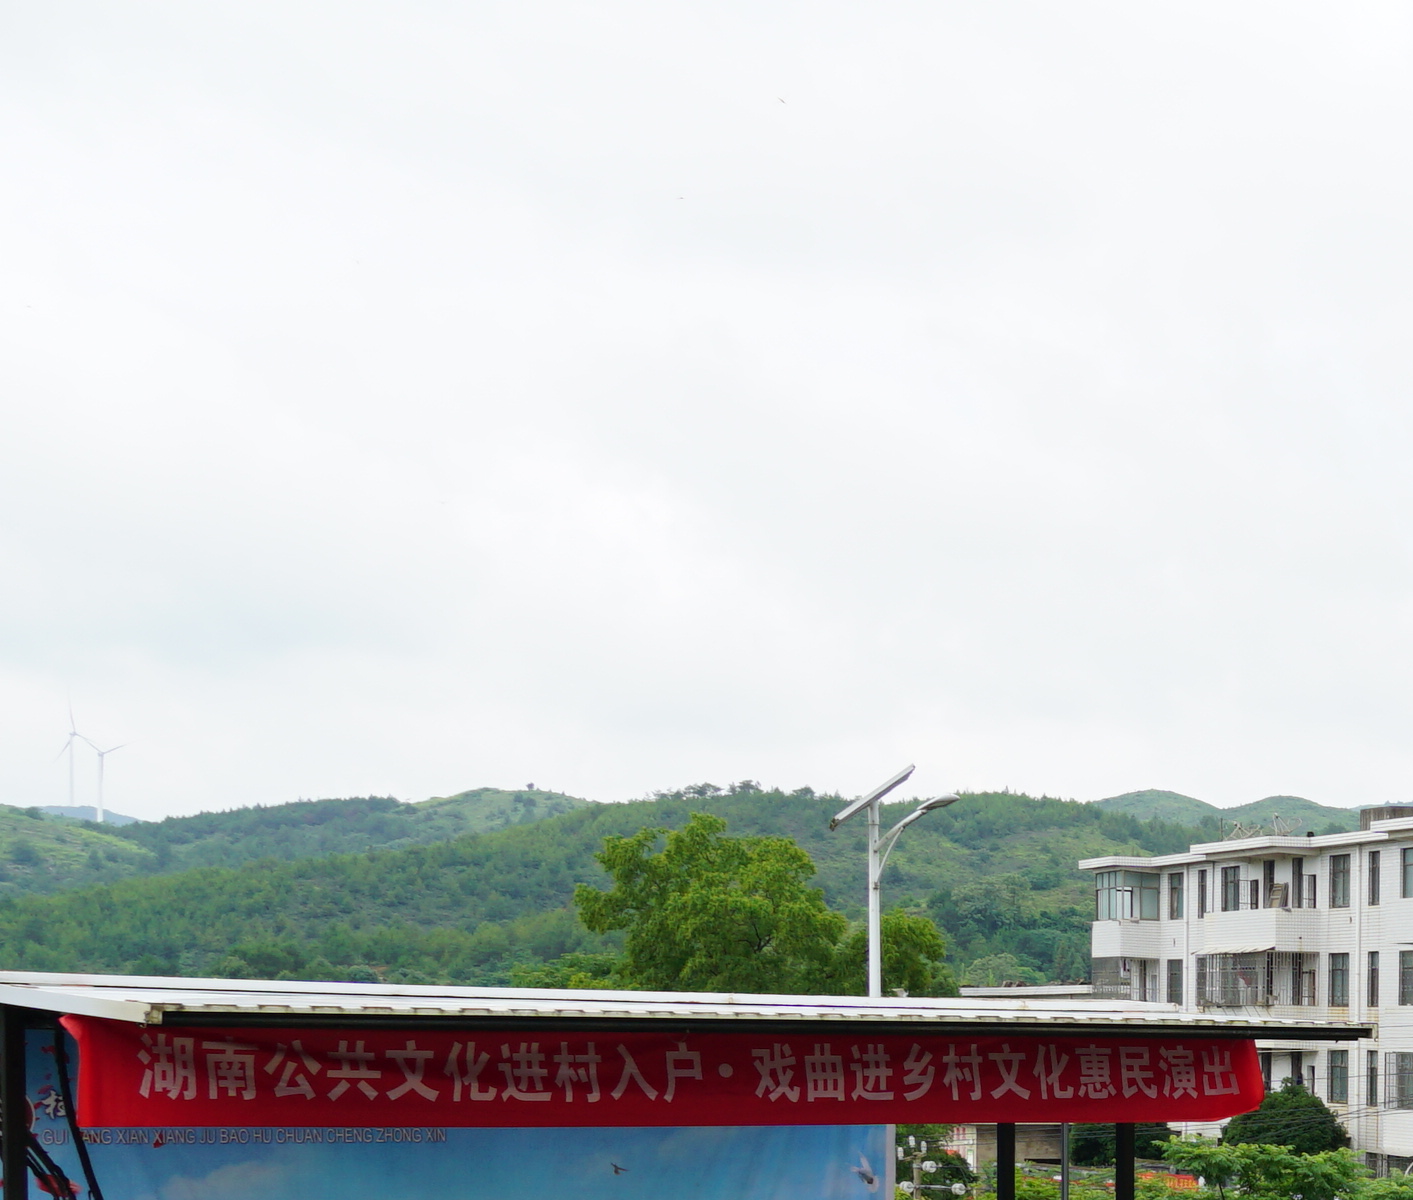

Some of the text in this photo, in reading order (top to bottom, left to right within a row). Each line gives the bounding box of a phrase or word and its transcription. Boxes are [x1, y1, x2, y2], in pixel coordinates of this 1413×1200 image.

[136, 1033, 1241, 1104] 湖南公共文化进村入户·戏曲进乡村文化惠民演出
[116, 1128, 149, 1144] XIAN
[153, 1128, 195, 1144] XIANG
[199, 1128, 216, 1144] JU
[219, 1128, 249, 1144] BAO
[253, 1127, 272, 1144] HU
[275, 1127, 323, 1144] CHUAN
[327, 1127, 373, 1144] CHENG
[376, 1126, 422, 1143] ZHONG
[425, 1126, 446, 1143] XIN
